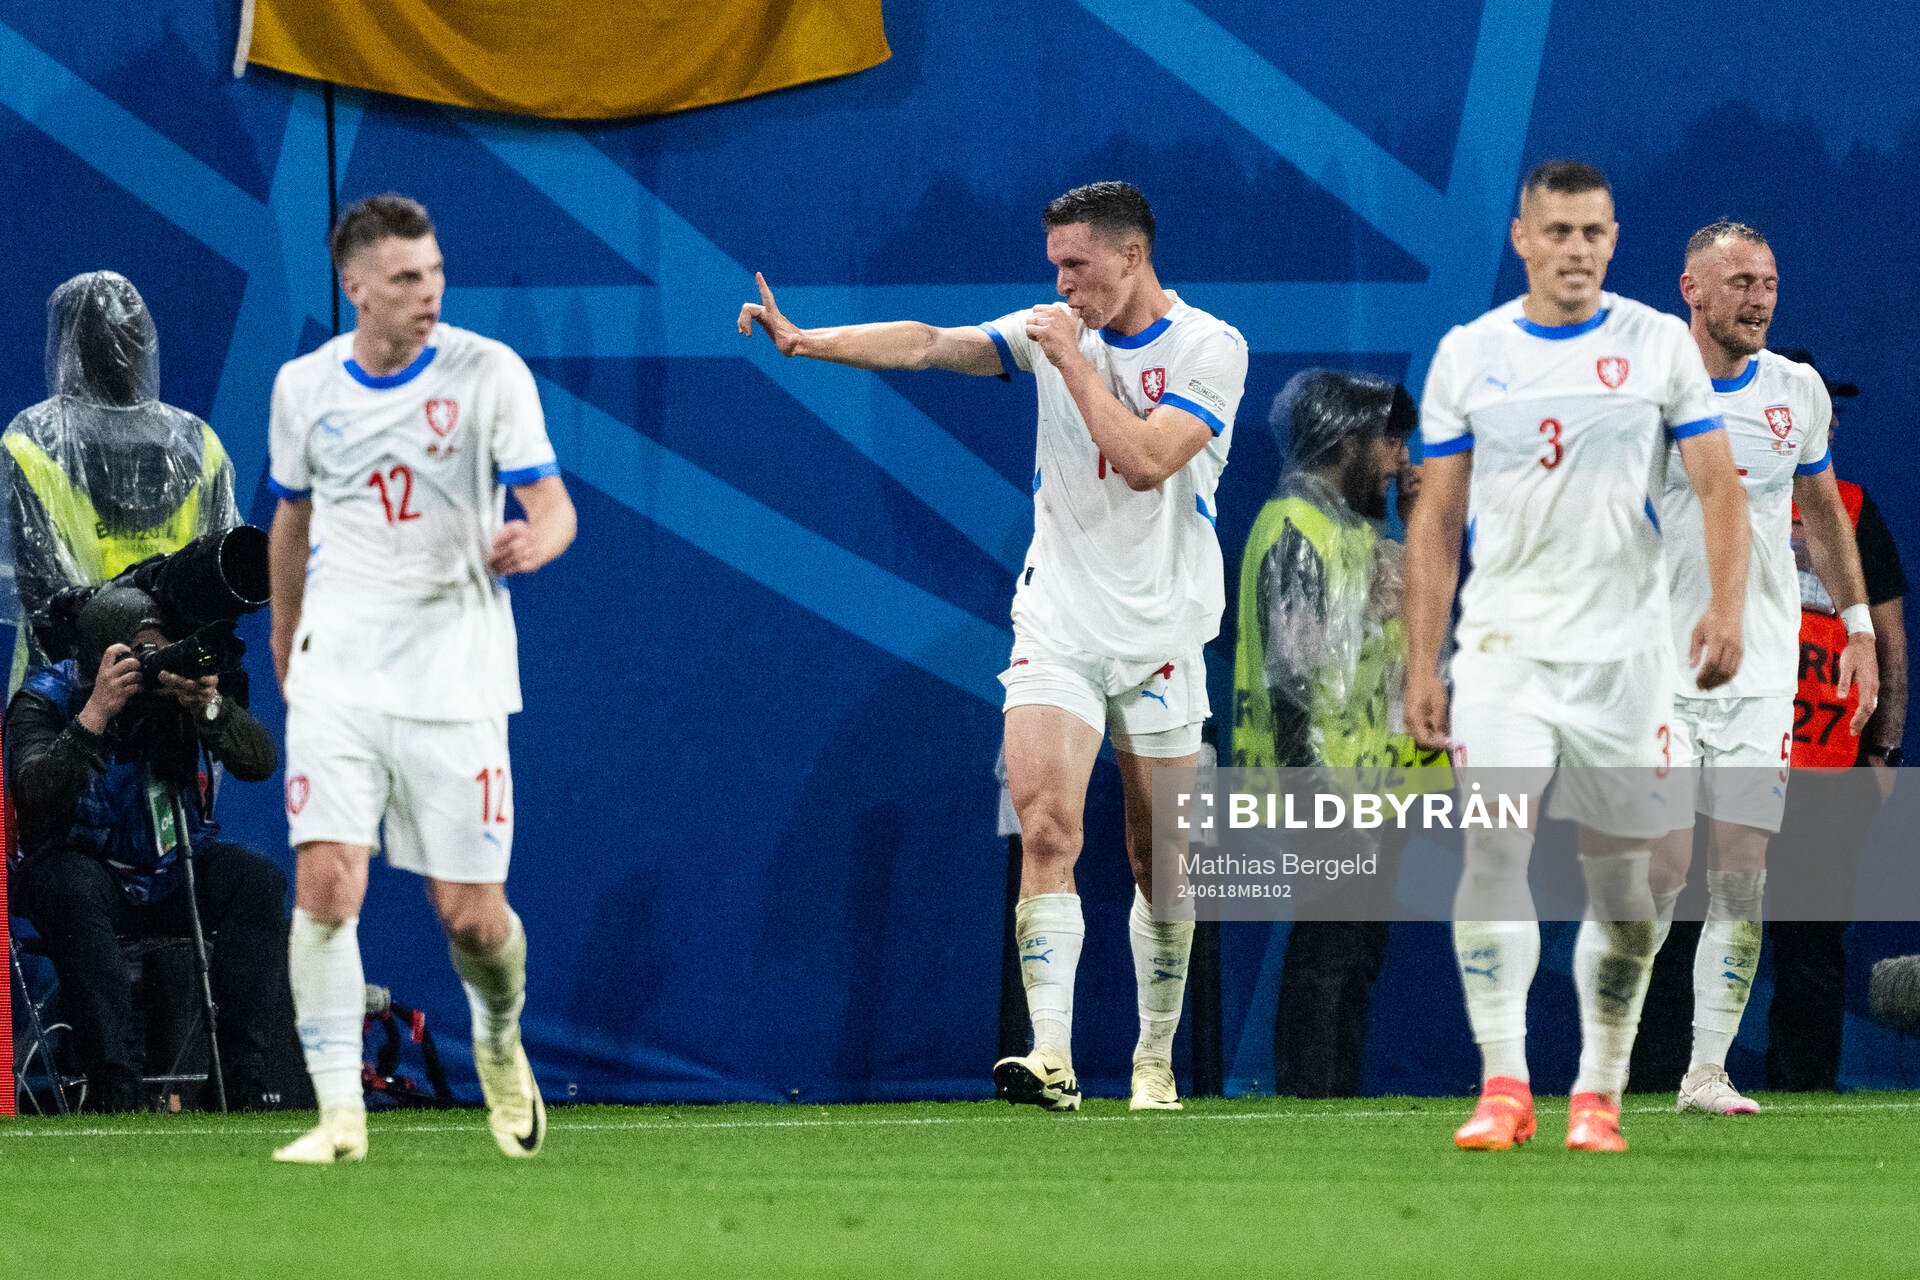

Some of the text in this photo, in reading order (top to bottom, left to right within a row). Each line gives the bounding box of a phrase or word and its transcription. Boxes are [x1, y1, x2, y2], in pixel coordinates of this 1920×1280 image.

[1539, 417, 1564, 470] 3
[368, 463, 422, 524] 12
[1793, 699, 1847, 747] 27
[1656, 724, 1671, 780] 3
[1779, 732, 1790, 783] 5
[475, 767, 507, 823] 12
